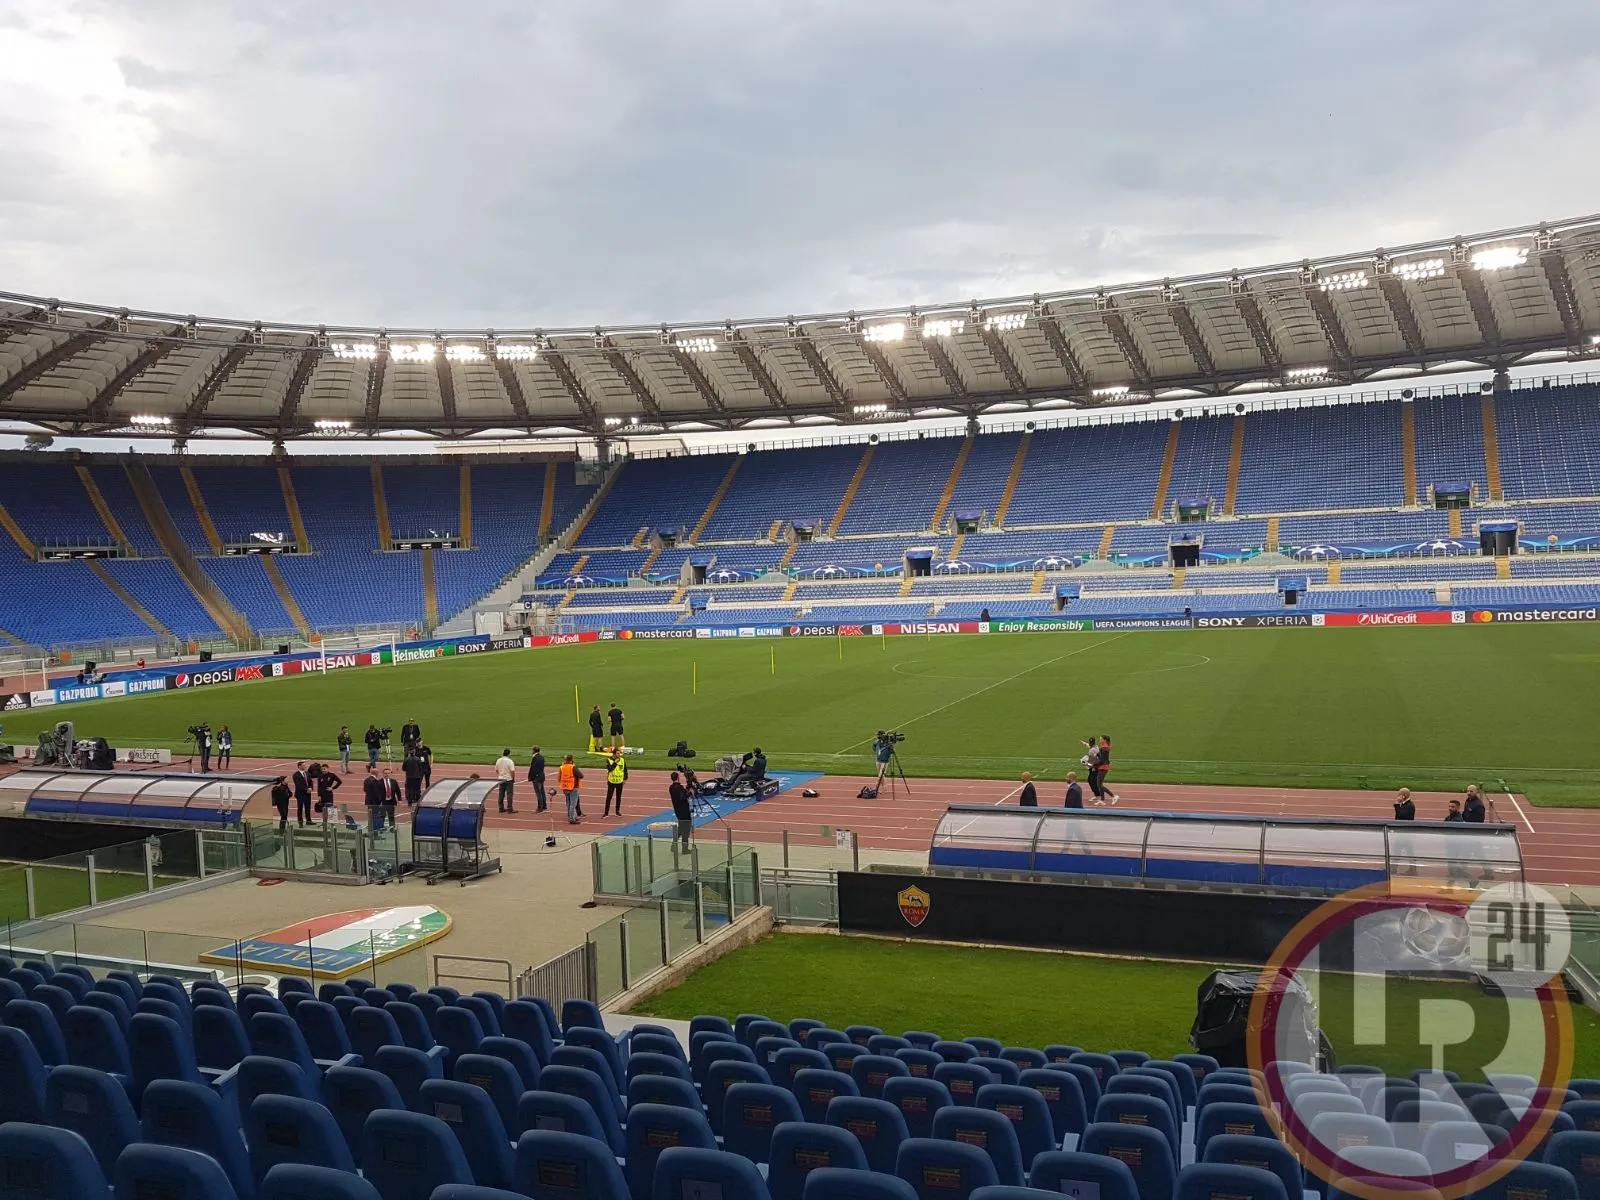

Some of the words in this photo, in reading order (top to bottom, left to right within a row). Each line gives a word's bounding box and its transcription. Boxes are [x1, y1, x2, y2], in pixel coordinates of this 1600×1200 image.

[1370, 613, 1417, 623] UniCredit
[1498, 608, 1596, 621] mastercard
[999, 622, 1024, 632] Enjoy
[1027, 621, 1084, 632] Responsibly
[1096, 620, 1114, 628] UEFA
[1116, 620, 1160, 628] CHAMPIONS
[1161, 619, 1191, 627] LEAGUE
[1198, 617, 1246, 627] SONY
[1257, 616, 1308, 626] XPERIA
[635, 629, 693, 639] mastercard
[804, 625, 835, 637] pepsi
[838, 624, 865, 636] MAX
[901, 624, 960, 634] NISSAN
[554, 634, 580, 645] UniCredit
[458, 643, 487, 654] SONY
[493, 639, 522, 650] XPERIA
[393, 649, 436, 662] Heineken
[301, 655, 356, 672] NISSAN
[193, 669, 232, 687] pepsi
[235, 664, 264, 682] MAX
[129, 679, 164, 692] GAZPROM
[60, 687, 99, 702] GAZPROM
[4, 703, 27, 711] adidas
[135, 752, 160, 760] RESPECT
[238, 944, 354, 966] ITALIA
